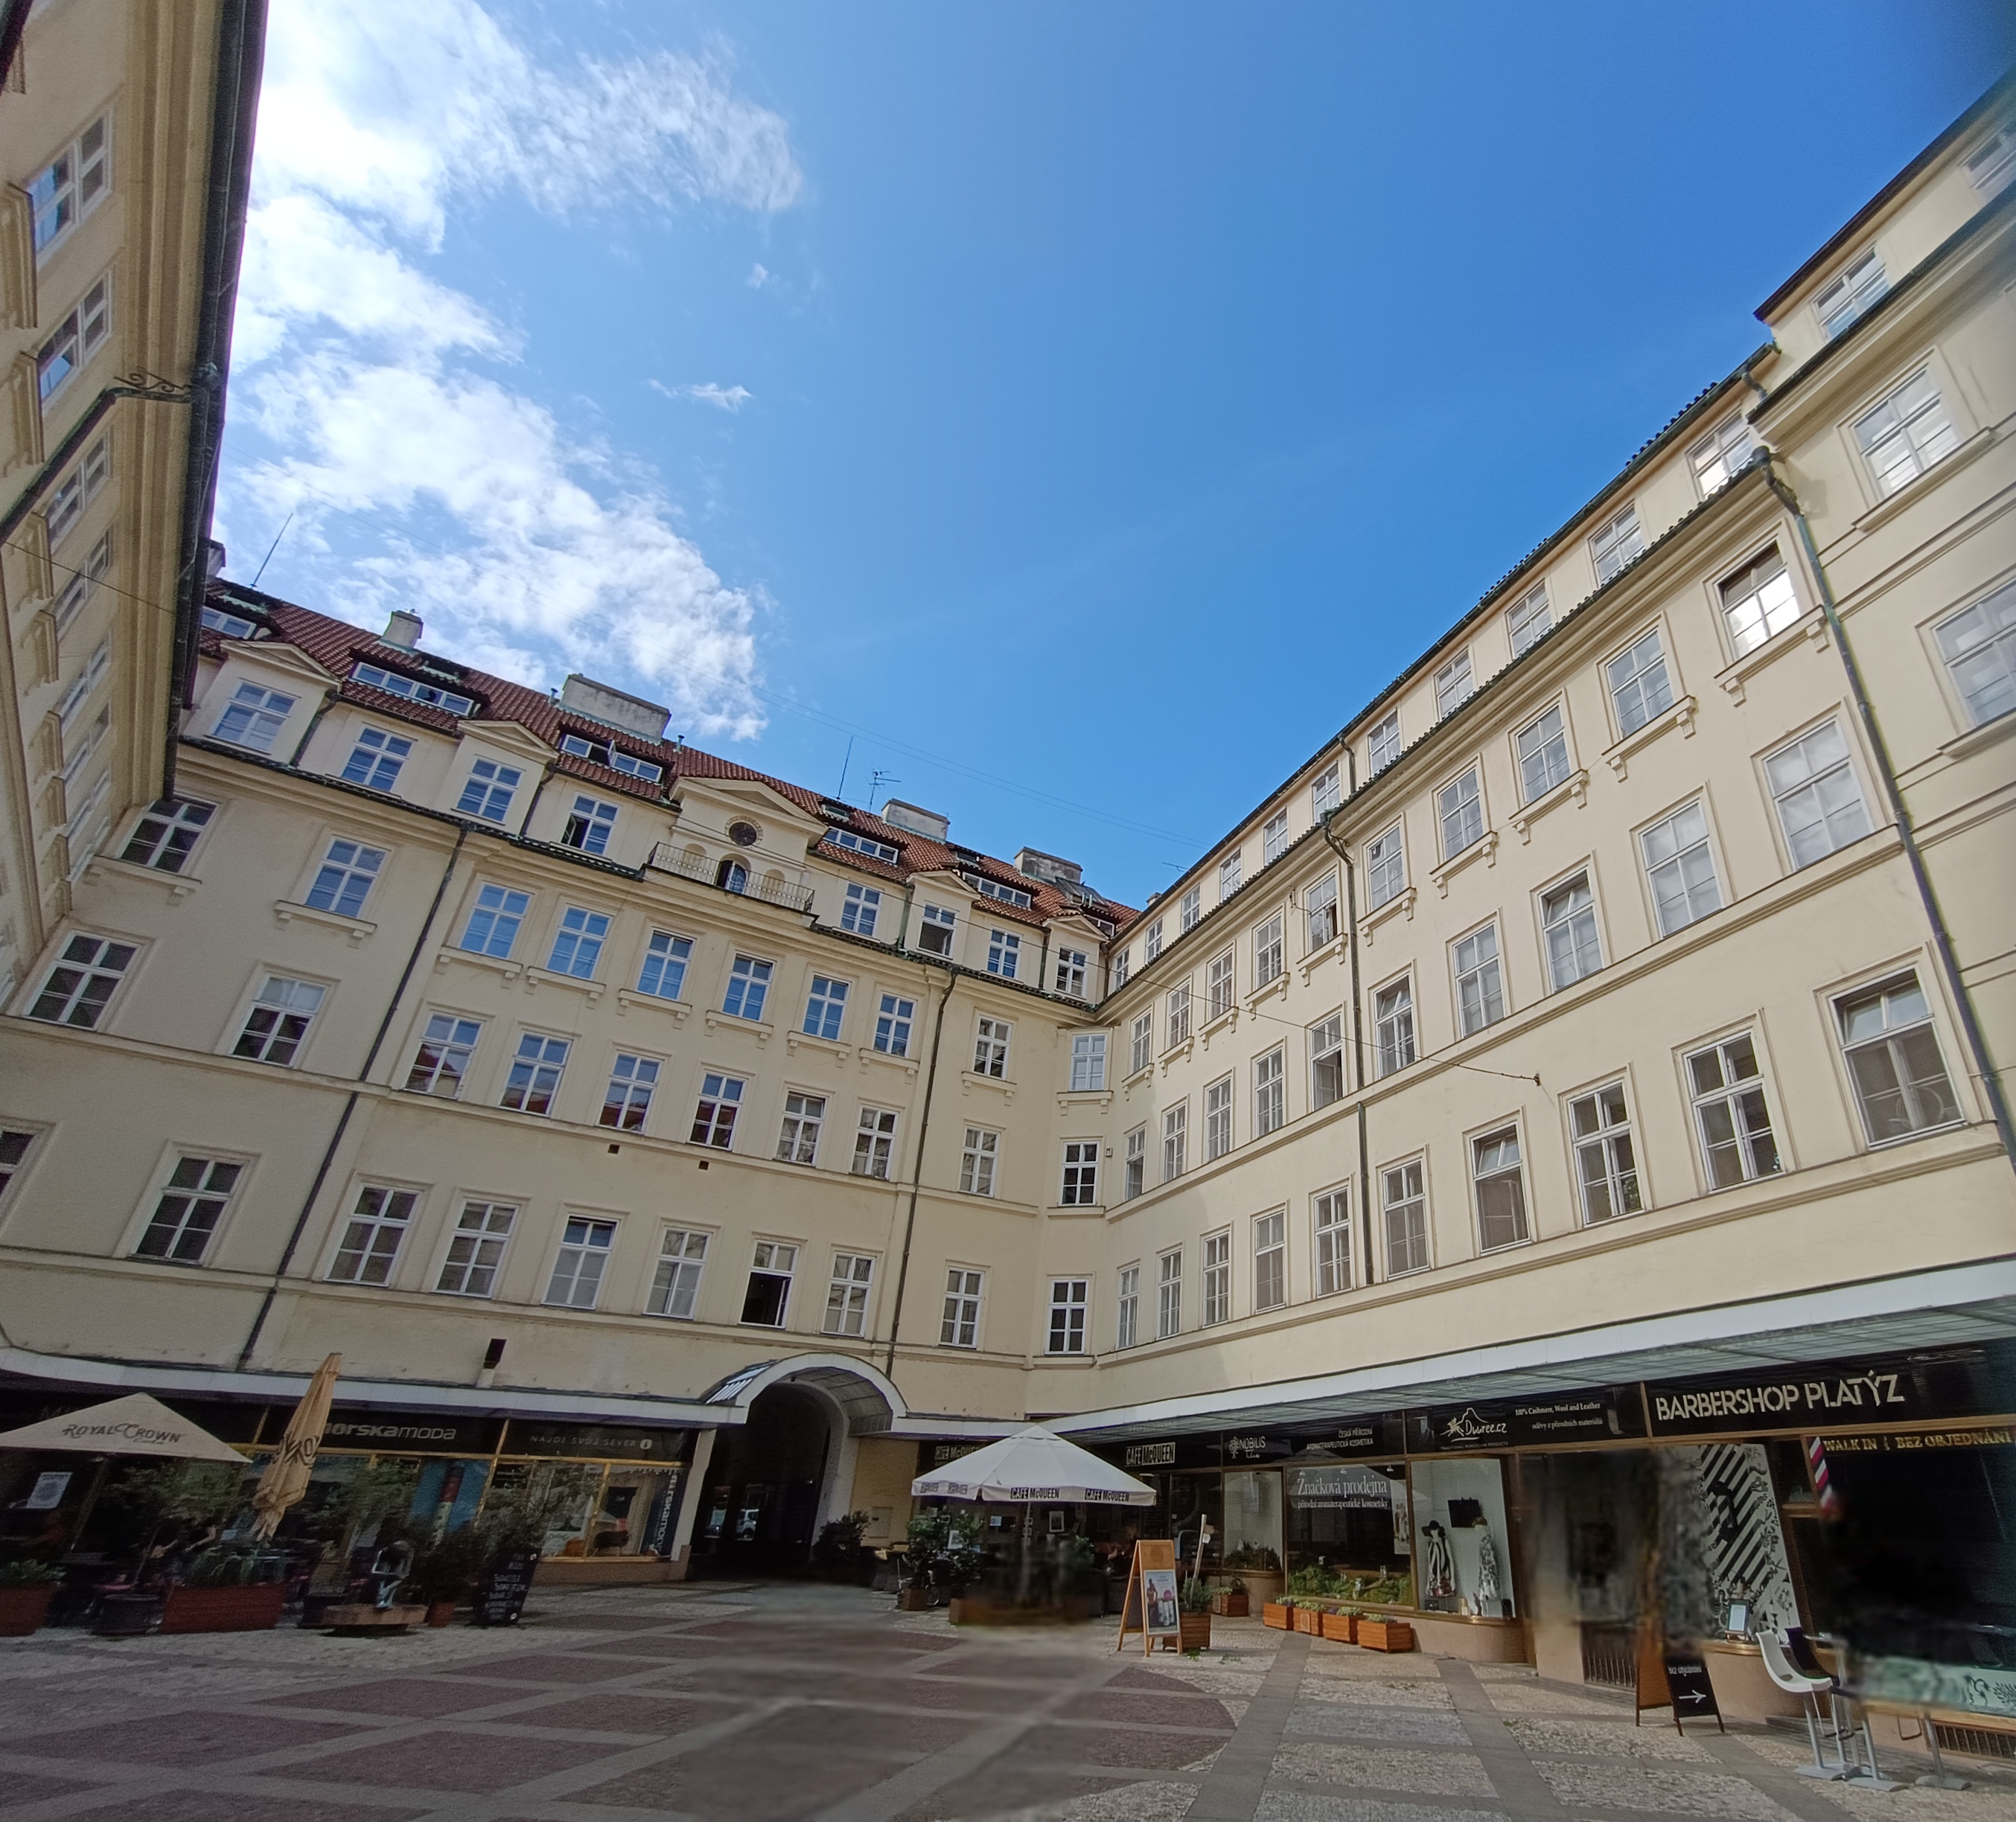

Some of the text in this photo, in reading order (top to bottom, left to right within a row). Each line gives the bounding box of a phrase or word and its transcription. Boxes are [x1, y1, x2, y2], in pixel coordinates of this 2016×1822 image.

[1656, 1369, 1905, 1421] BARBERSHOP PLATÝZ
[1528, 1406, 1554, 1416] Cashmere,
[1554, 1404, 1569, 1413] Wool
[1569, 1402, 1579, 1411] and
[1580, 1401, 1601, 1410] Leather
[63, 1423, 182, 1442] ROYAL CROWN
[530, 1436, 566, 1445] NAJDI
[603, 1439, 637, 1447] SEVER
[1824, 1438, 1861, 1451] WALK
[1861, 1437, 1878, 1451] IN
[1895, 1436, 1923, 1449] BEZ
[1126, 1446, 1142, 1466] CAFE
[1011, 1487, 1059, 1499] CAFE McQUEEN
[1298, 1475, 1388, 1498] Značková prodejna
[1085, 1488, 1130, 1502] CAFE McQUEEN
